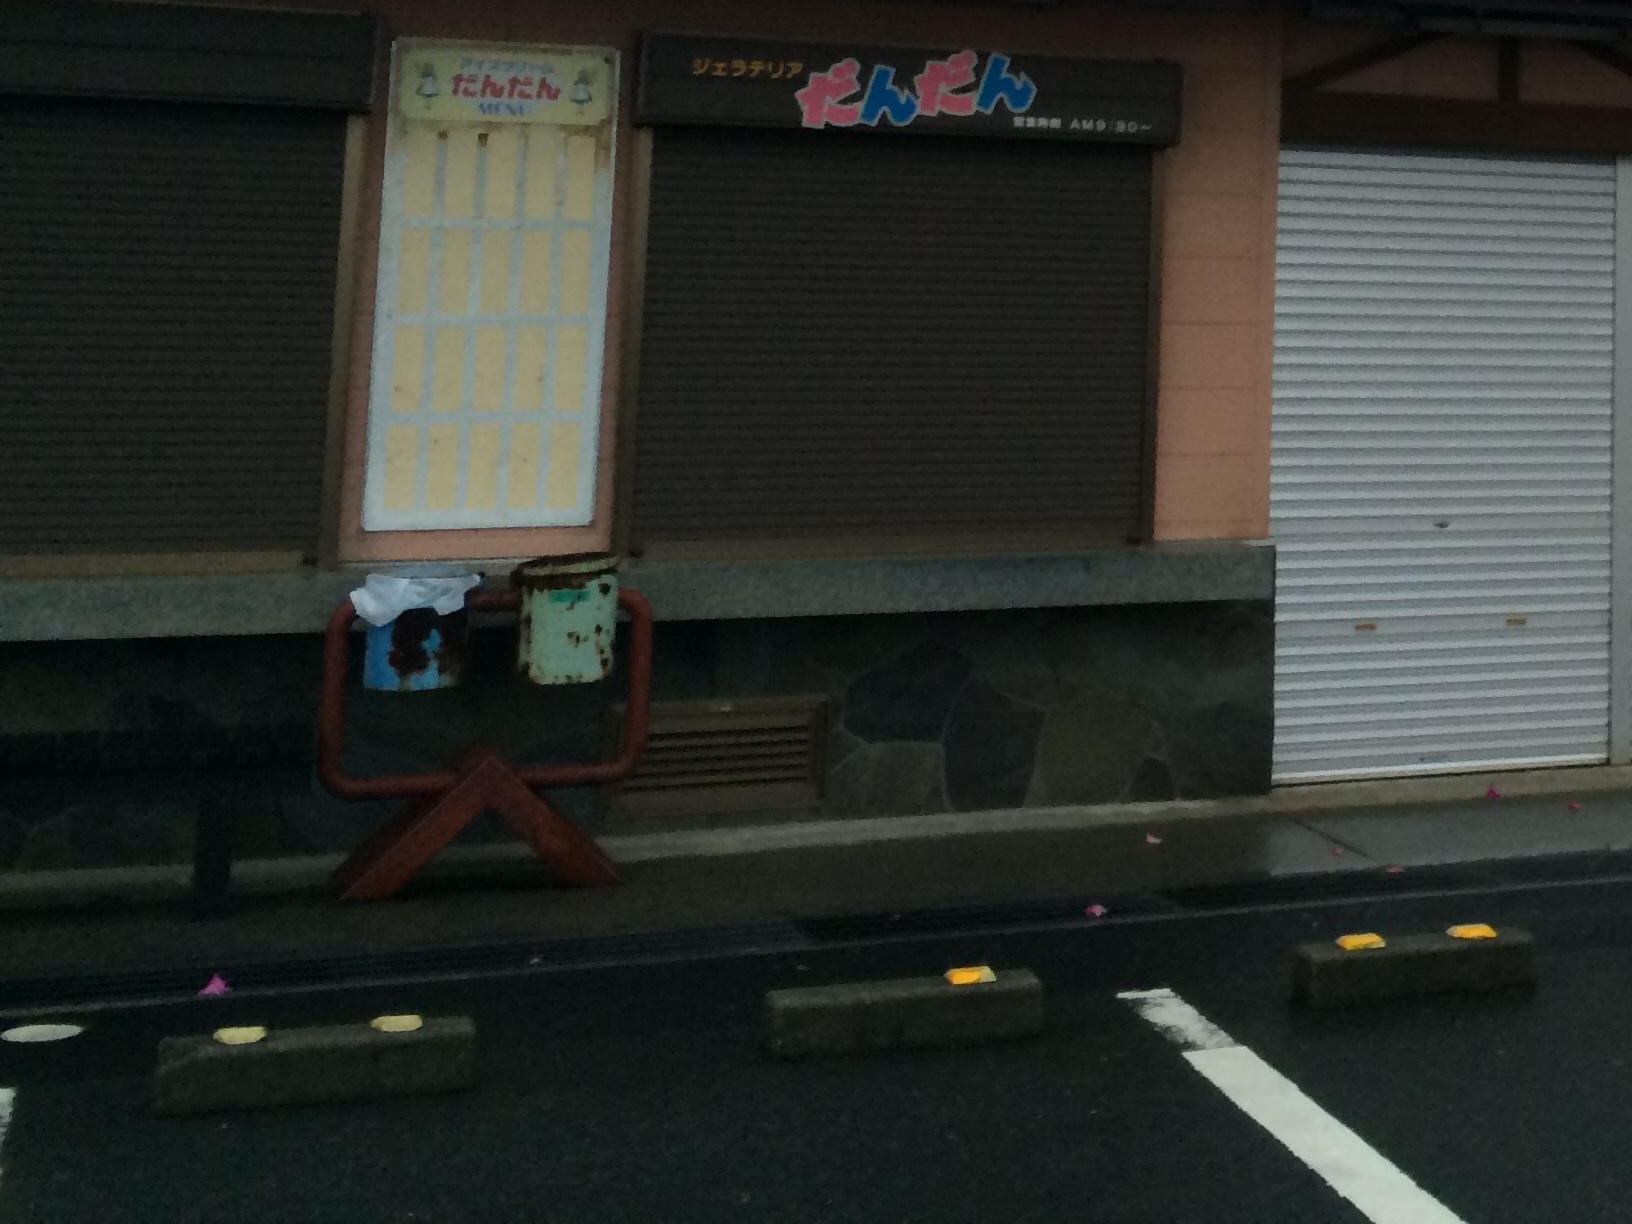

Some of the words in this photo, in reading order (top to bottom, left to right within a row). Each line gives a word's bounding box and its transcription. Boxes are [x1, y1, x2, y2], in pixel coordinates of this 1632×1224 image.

[692, 58, 804, 79] ジェラテリア
[451, 73, 561, 101] だんだん
[794, 48, 1038, 129] だんだん
